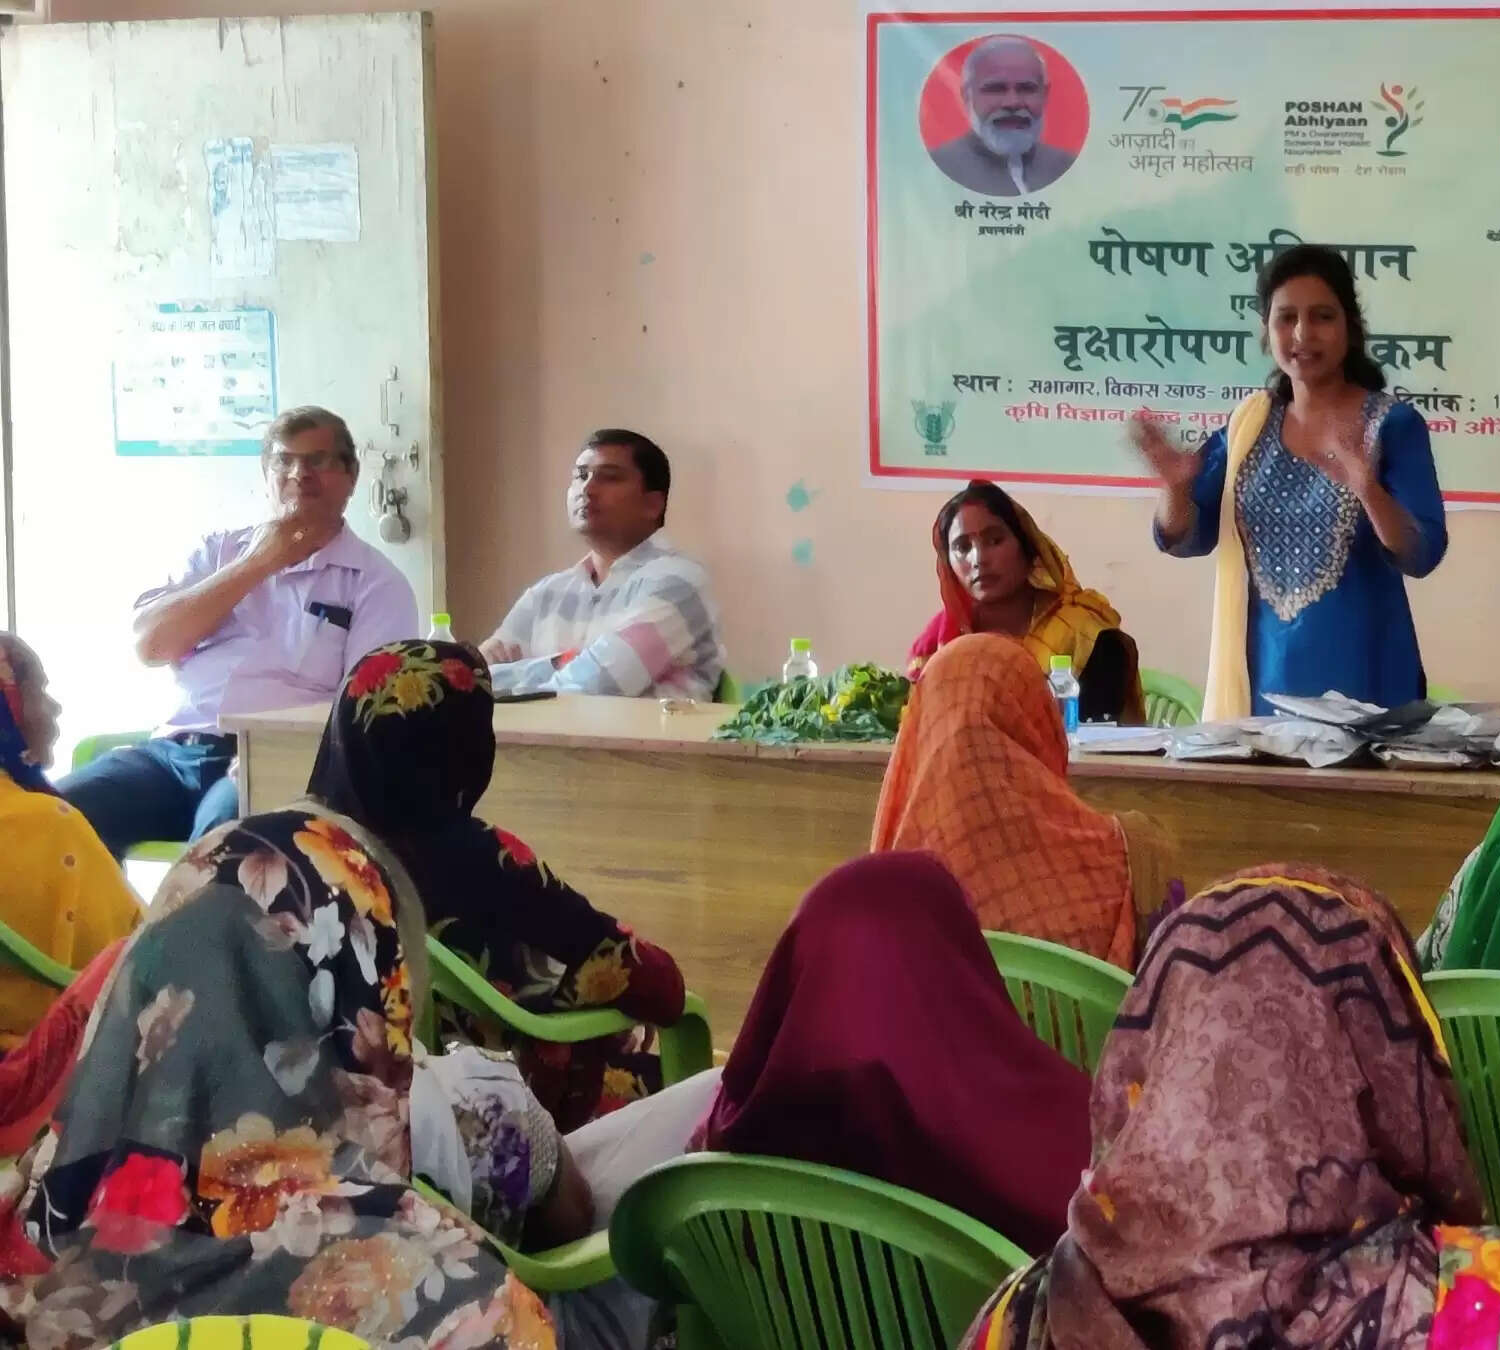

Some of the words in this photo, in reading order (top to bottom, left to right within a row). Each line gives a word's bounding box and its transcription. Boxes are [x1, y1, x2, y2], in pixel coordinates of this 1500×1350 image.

[1284, 101, 1363, 114] POSHAN
[1284, 115, 1368, 129] Abhiyaan
[1128, 154, 1176, 178] अमृत
[1182, 149, 1255, 174] महोत्सव
[954, 200, 975, 219] श्री
[1017, 202, 1051, 220] मोदी
[1088, 226, 1214, 277] पोषण
[1054, 314, 1254, 371] वृक्षारोपण
[952, 373, 1001, 394] स्थान
[1104, 376, 1160, 398] विकास
[1004, 402, 1049, 424] कृषि
[1056, 402, 1125, 423] विज्ञान
